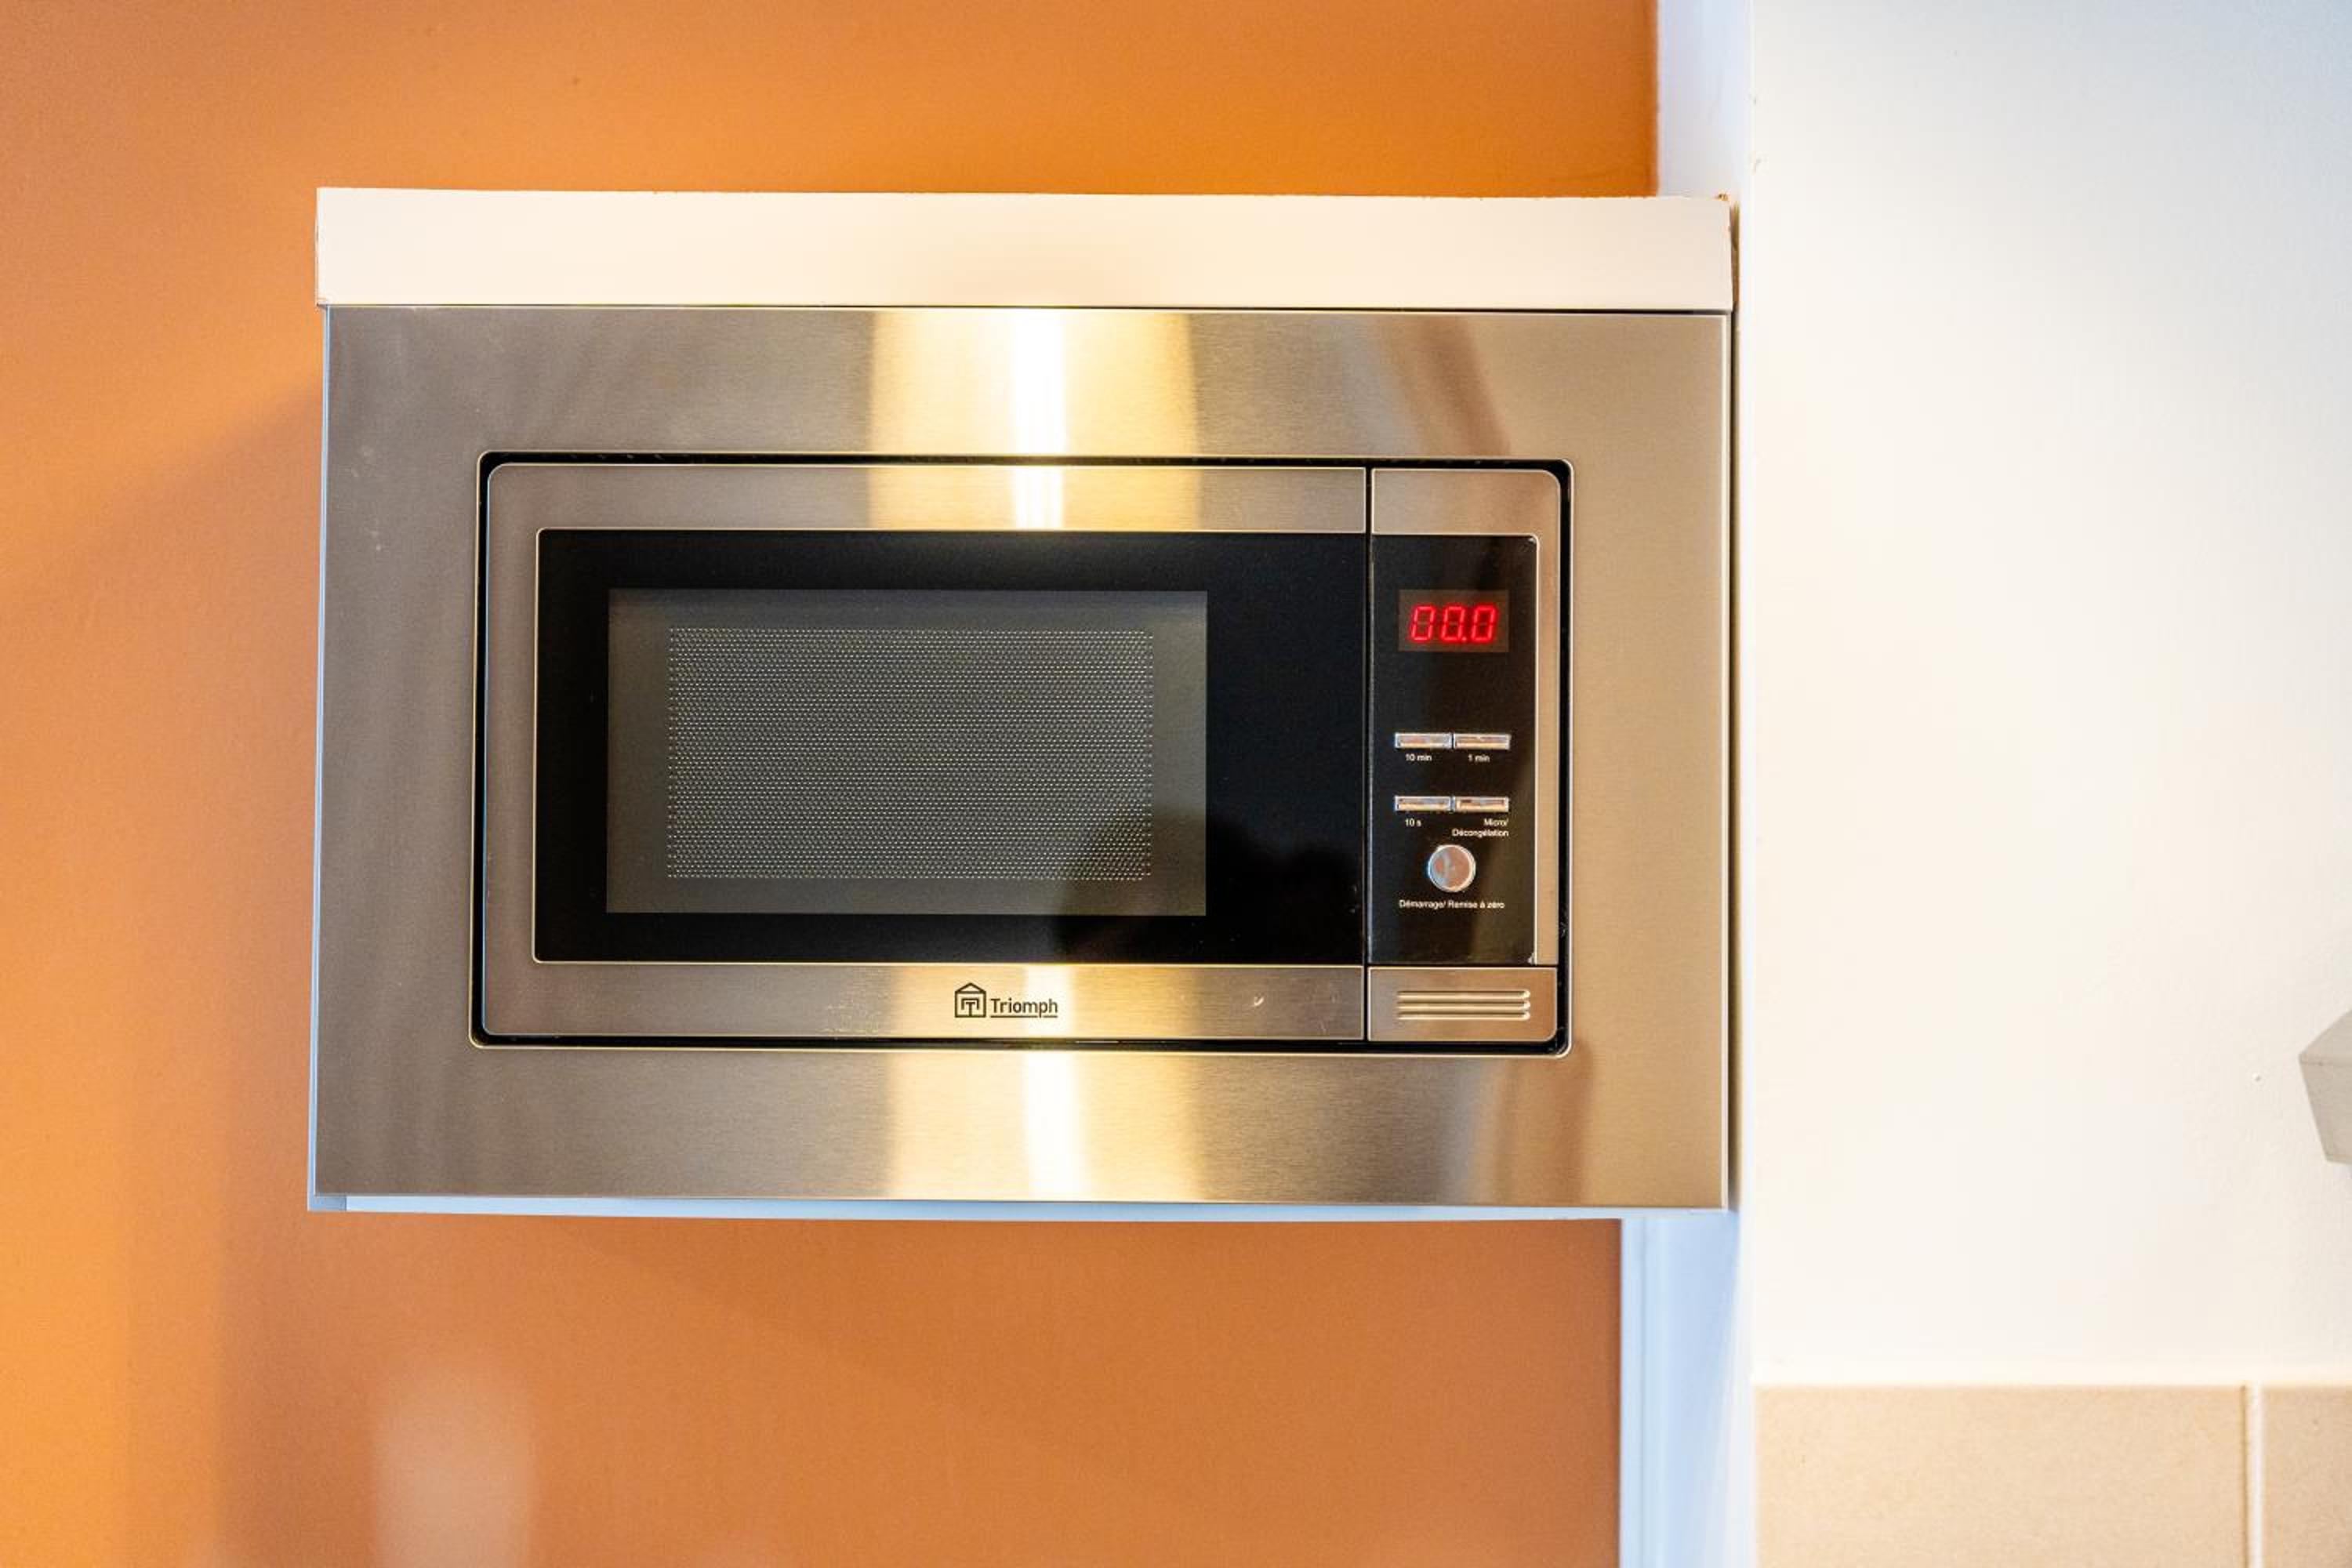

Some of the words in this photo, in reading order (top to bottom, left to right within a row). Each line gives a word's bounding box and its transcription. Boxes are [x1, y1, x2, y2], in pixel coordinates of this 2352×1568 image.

[1475, 753, 1490, 762] min
[1405, 818, 1415, 827] 10
[1452, 828, 1509, 838] Décongélation
[1399, 899, 1446, 909] Démarrage/
[1448, 899, 1478, 909] Remise
[1479, 899, 1486, 909] à
[1487, 899, 1504, 909] zéro
[989, 997, 1058, 1018] Triomph
